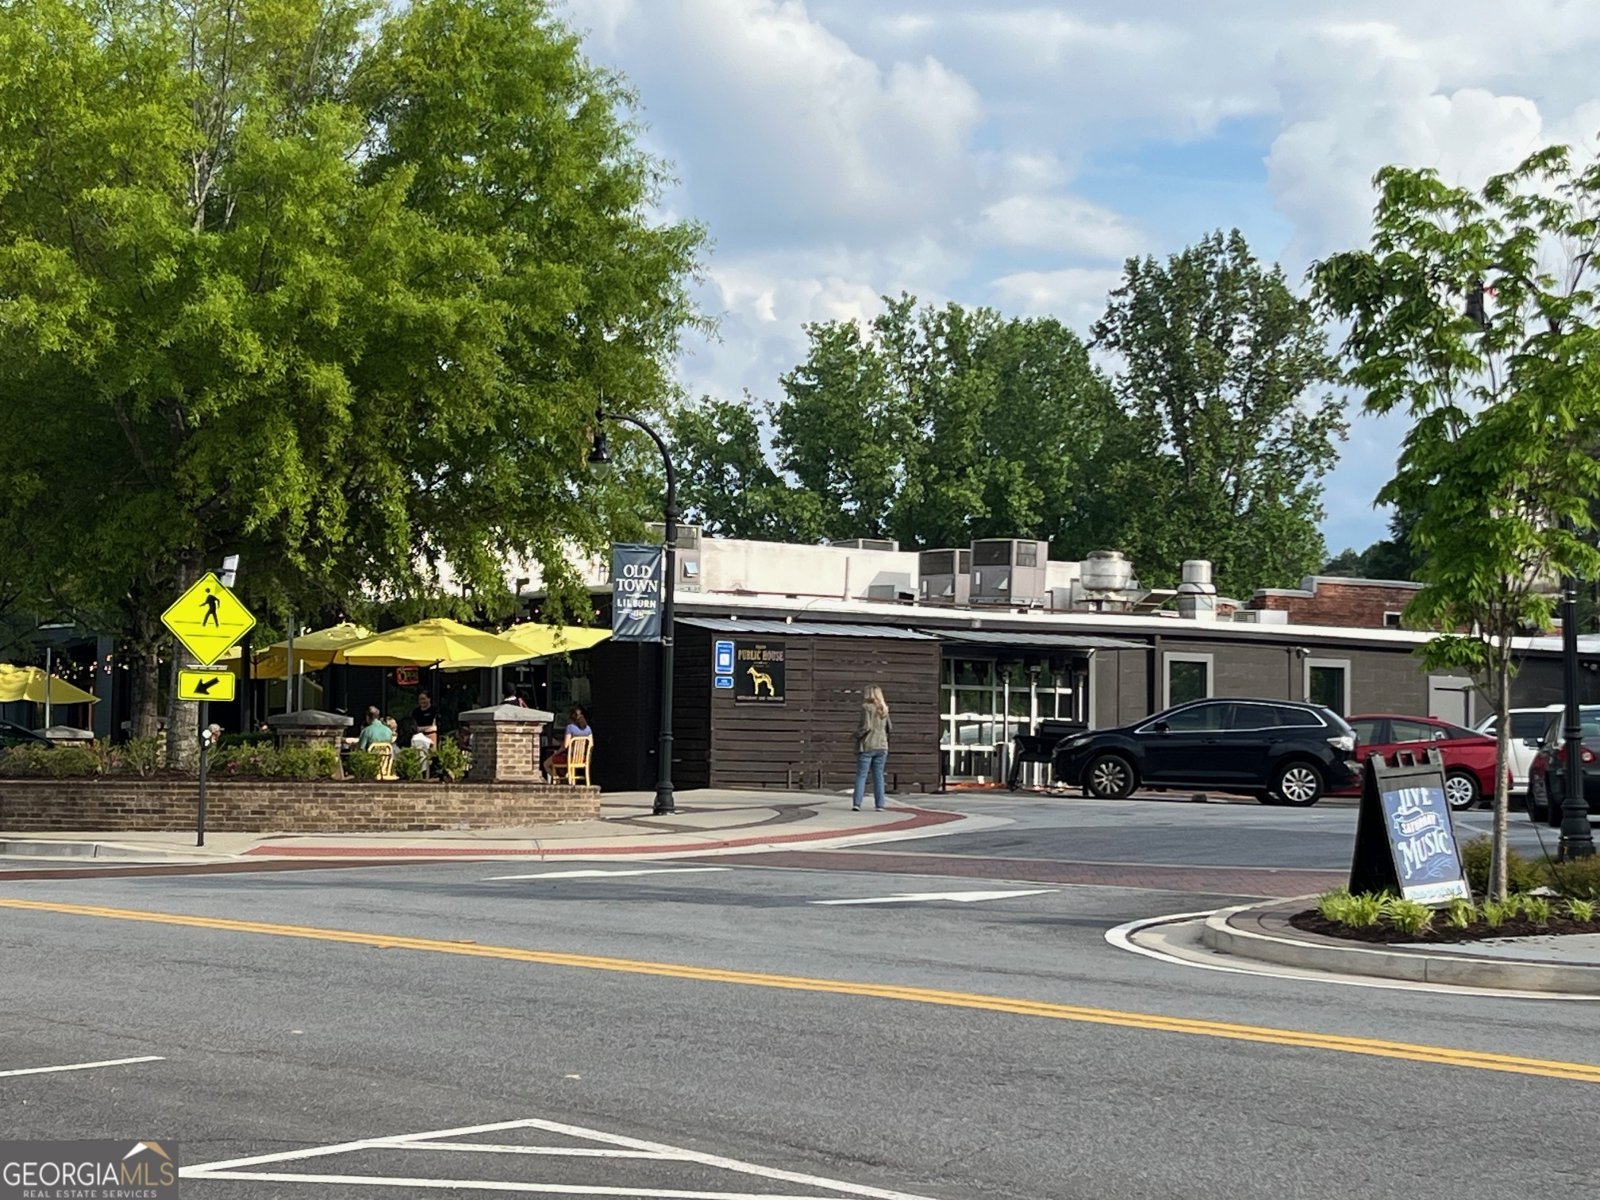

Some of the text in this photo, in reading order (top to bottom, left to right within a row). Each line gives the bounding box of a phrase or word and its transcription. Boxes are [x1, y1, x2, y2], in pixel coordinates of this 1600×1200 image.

[623, 564, 652, 578] OLD
[616, 578, 658, 592] TOWN
[617, 599, 656, 608] LILBURN
[738, 649, 762, 660] PUBLIC
[1398, 787, 1432, 813] LIVE
[1398, 829, 1452, 880] MUSIC
